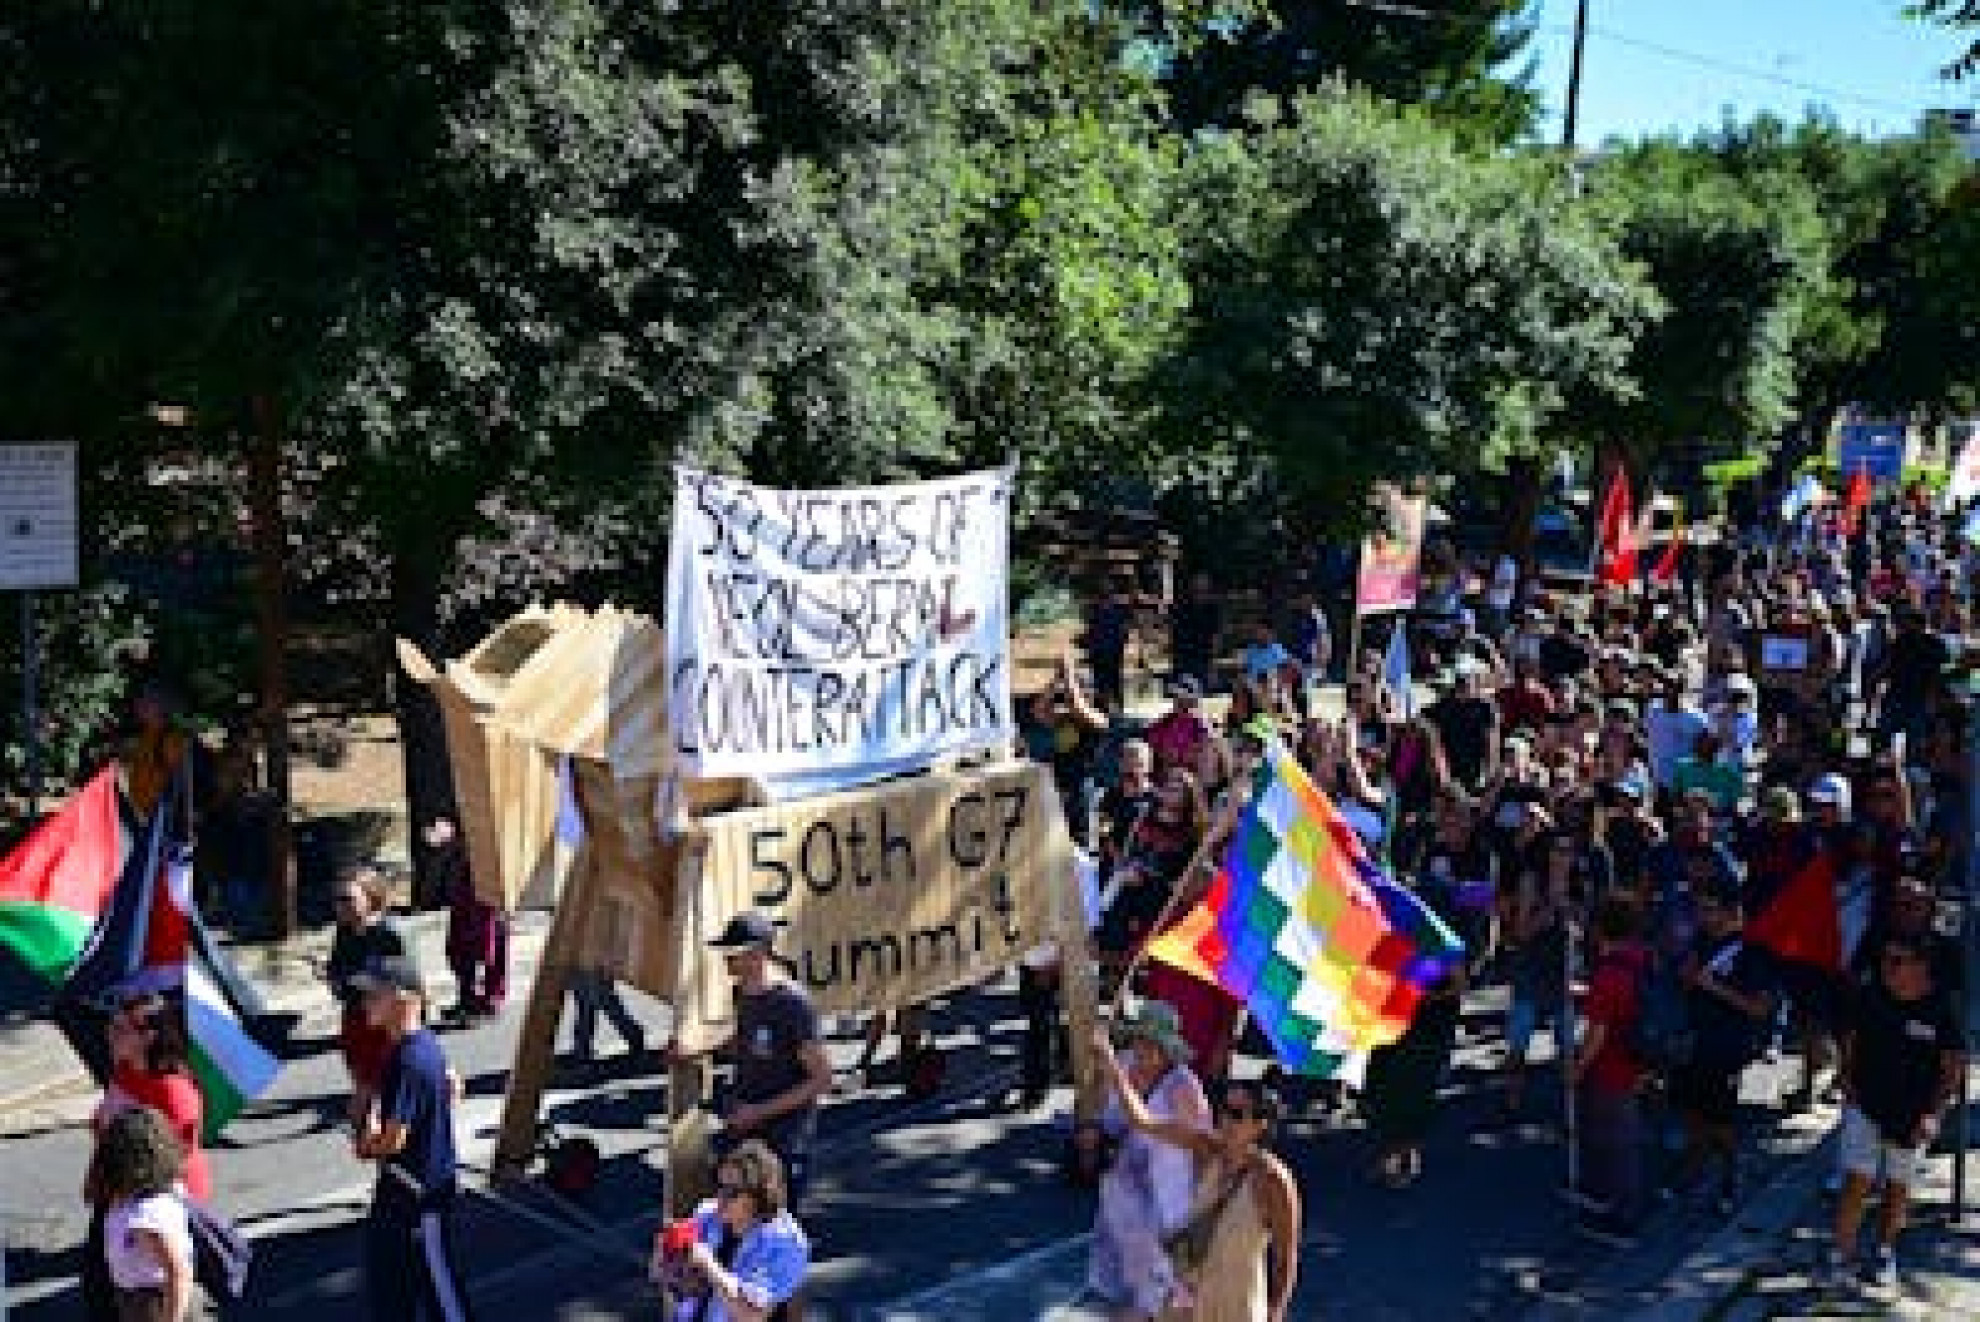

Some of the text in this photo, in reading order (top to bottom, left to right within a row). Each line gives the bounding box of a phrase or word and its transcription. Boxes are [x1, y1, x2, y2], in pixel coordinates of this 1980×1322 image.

[778, 492, 916, 574] YEARS
[930, 484, 981, 566] OF
[706, 573, 976, 663] NEOLBERAL
[751, 790, 1026, 906] 50th G7
